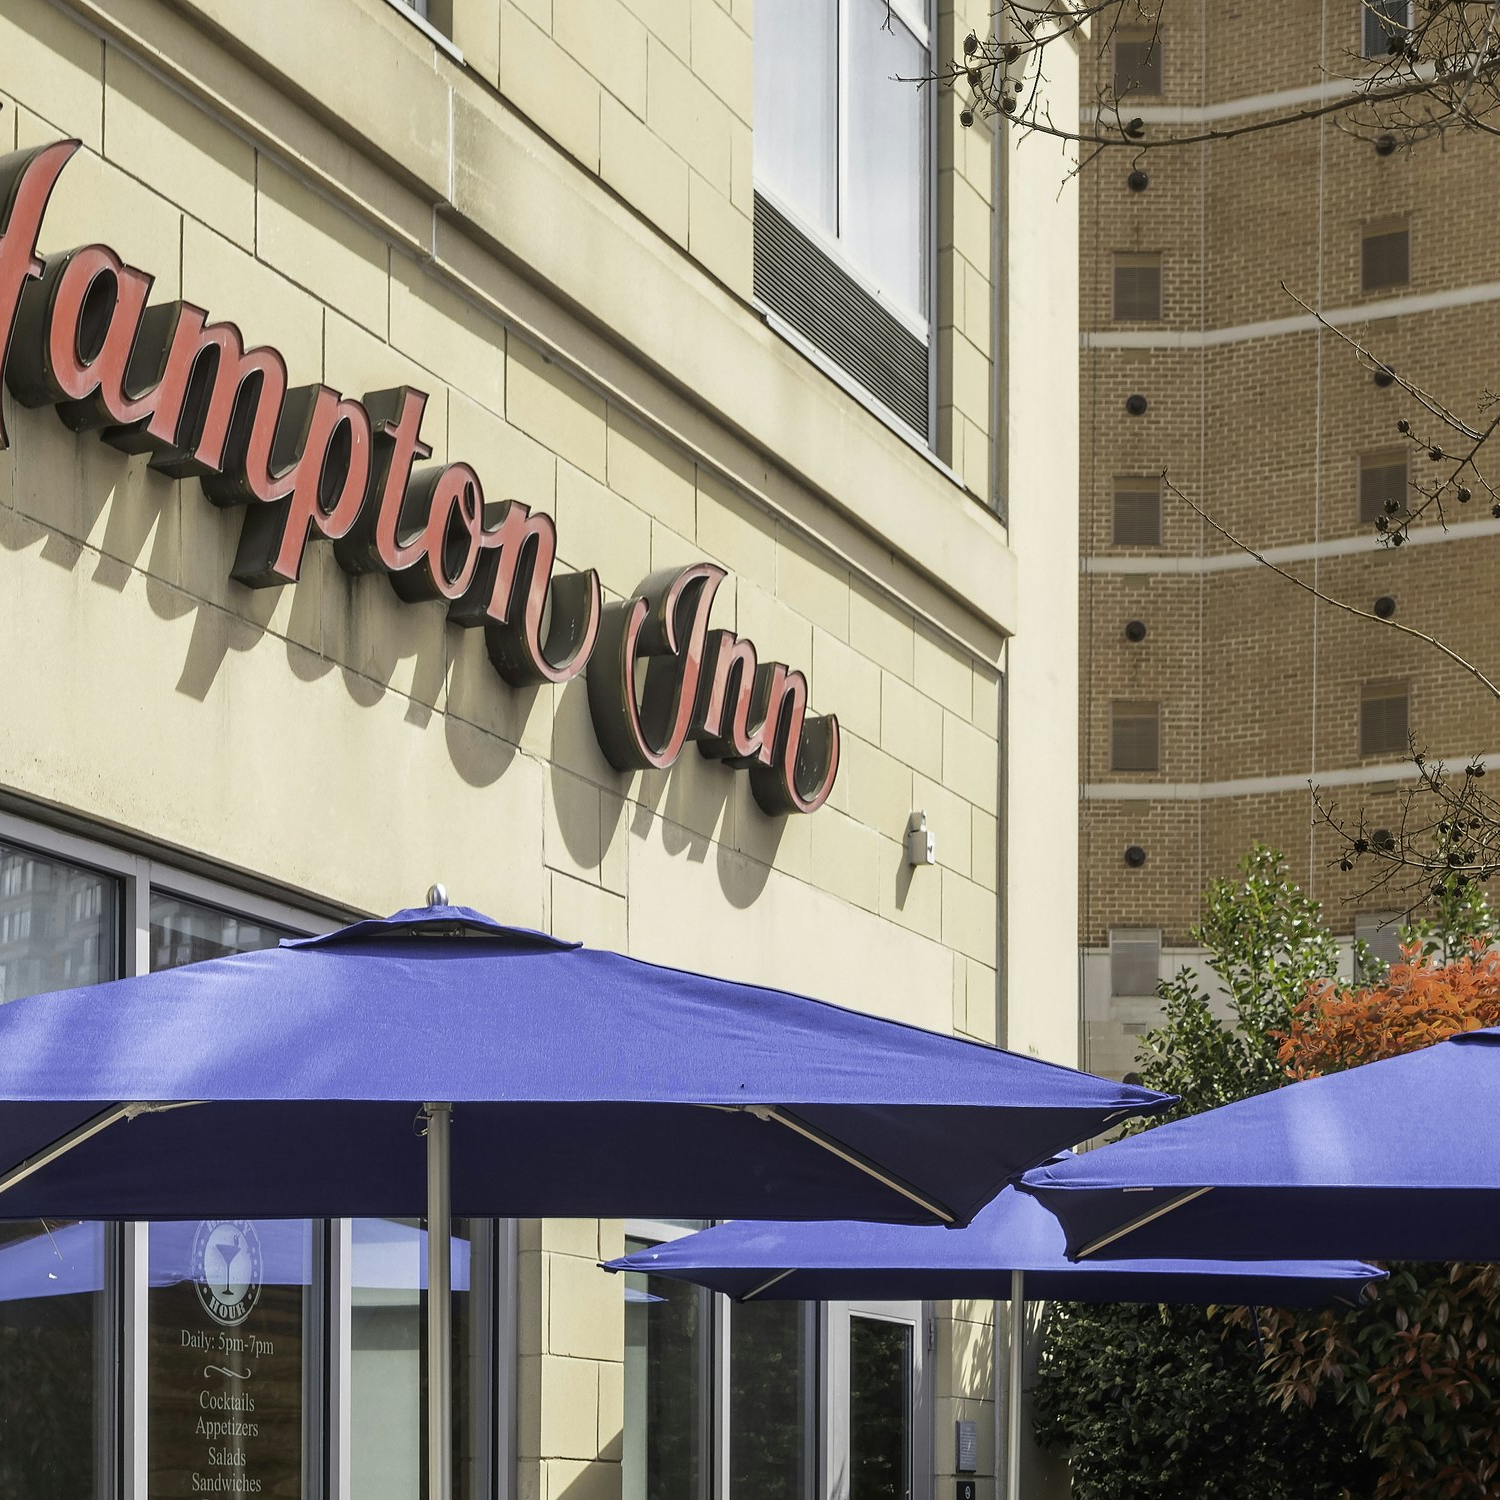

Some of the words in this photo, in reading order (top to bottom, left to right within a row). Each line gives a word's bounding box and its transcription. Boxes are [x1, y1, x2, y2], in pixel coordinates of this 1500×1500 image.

[587, 562, 840, 815] Inn
[209, 1295, 246, 1319] HOUR
[181, 1329, 214, 1353] Daily:
[218, 1332, 274, 1358] 5pm-7pm
[199, 1390, 255, 1412] Cocktails
[195, 1416, 259, 1440] Appetizers
[208, 1446, 247, 1466] Salads
[192, 1472, 262, 1492] Sandwiches
